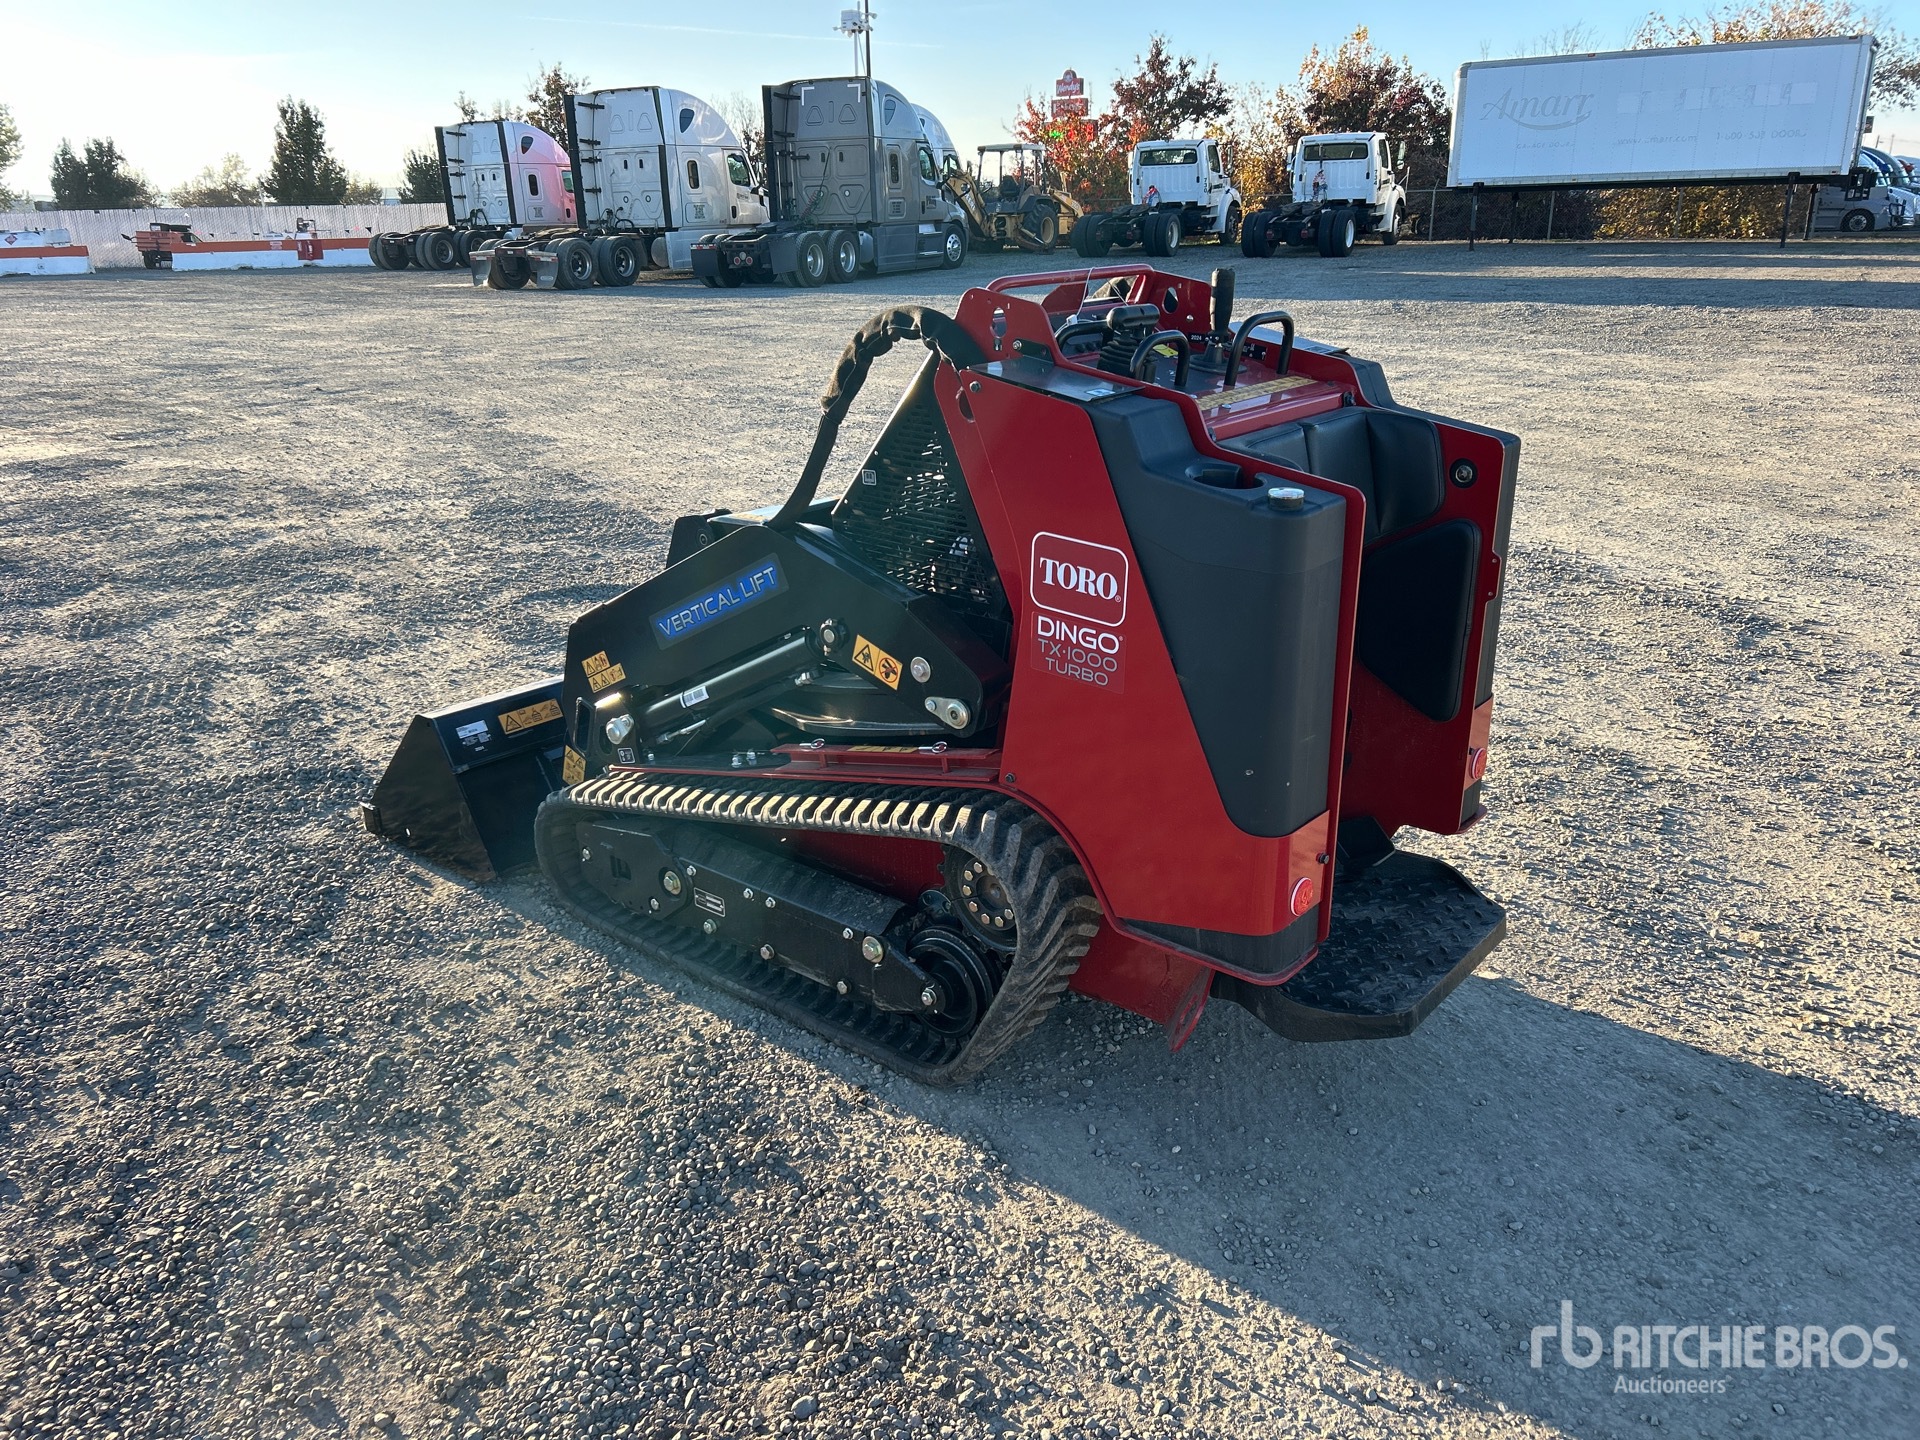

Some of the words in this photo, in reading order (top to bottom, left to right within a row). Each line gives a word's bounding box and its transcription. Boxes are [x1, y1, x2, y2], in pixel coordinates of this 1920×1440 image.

[1057, 81, 1080, 94] Wendy's
[1480, 87, 1595, 122] Amarr
[1039, 557, 1118, 600] TORO
[659, 588, 741, 635] VERTICAL
[740, 566, 776, 598] LIFT
[1037, 615, 1120, 655] DINGO
[1045, 656, 1109, 687] TURBO
